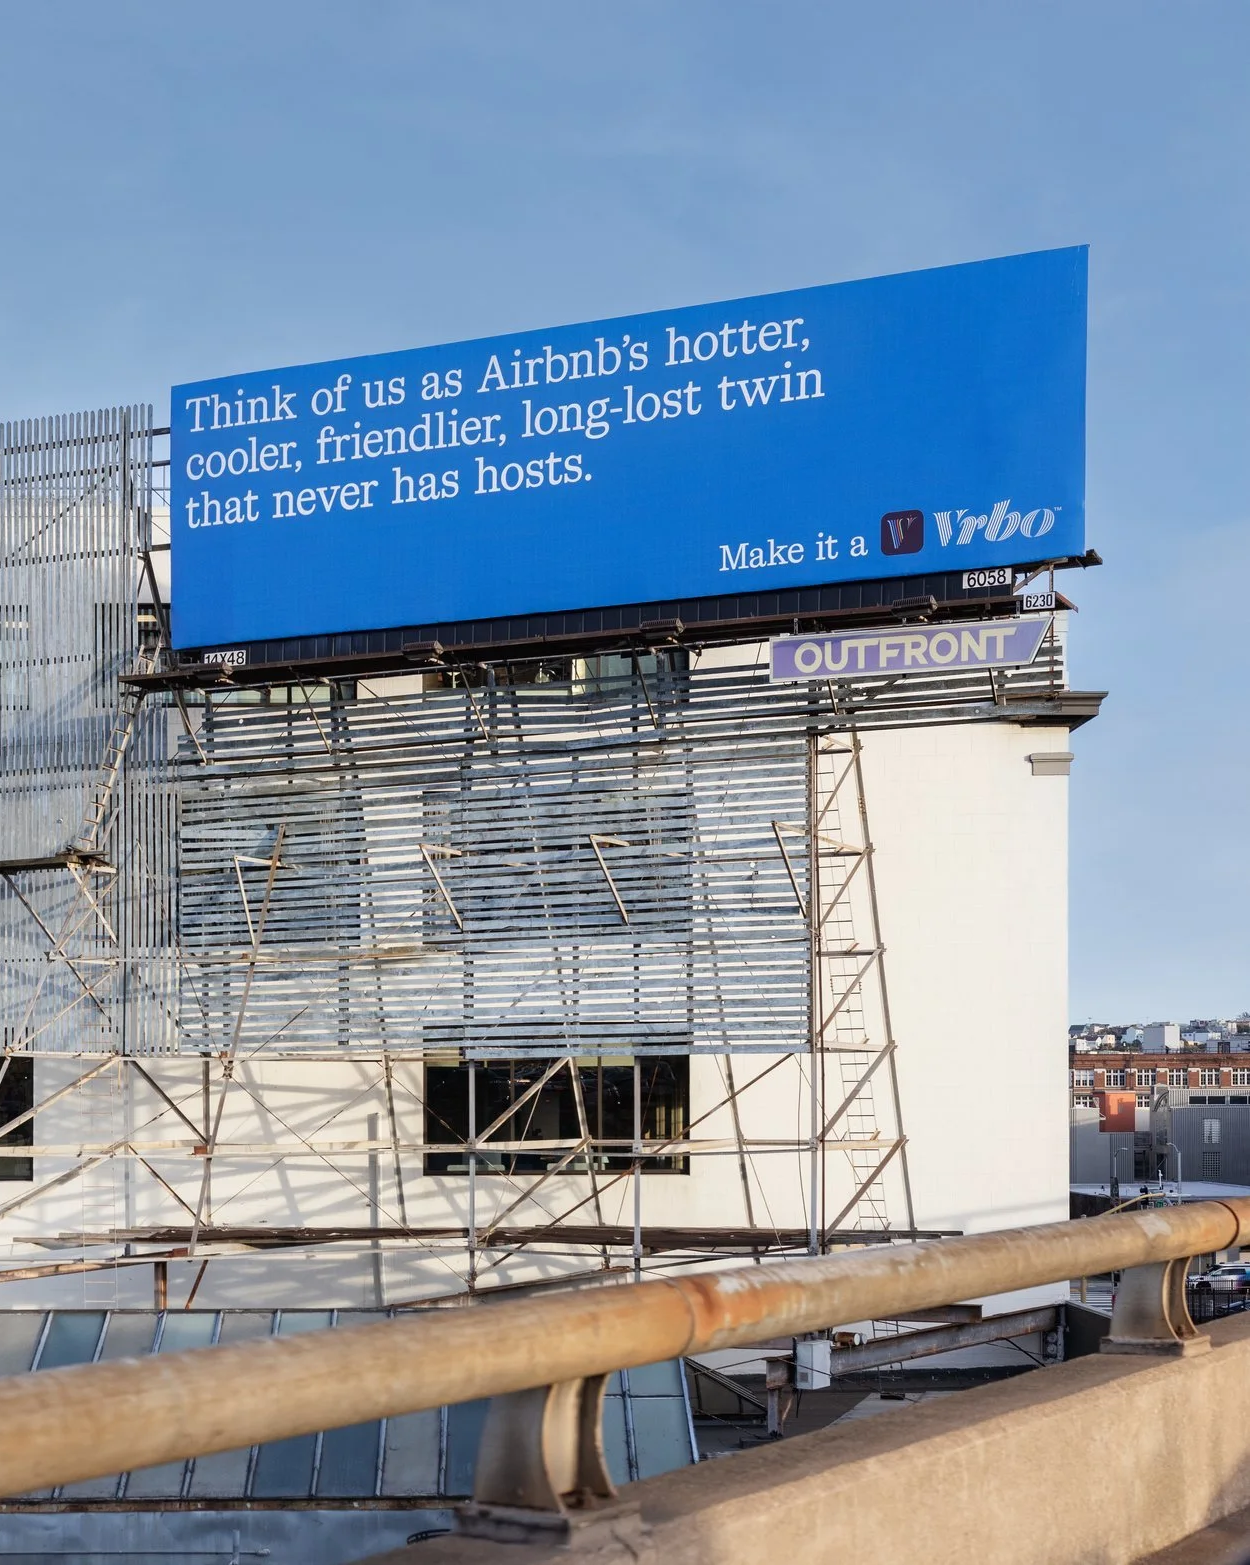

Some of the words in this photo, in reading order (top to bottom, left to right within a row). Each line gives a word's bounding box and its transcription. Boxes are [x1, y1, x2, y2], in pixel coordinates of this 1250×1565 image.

[185, 384, 298, 433] Think
[310, 373, 352, 416] of
[361, 376, 406, 409] us
[421, 368, 463, 401] as
[476, 334, 649, 394] Airbnb’s
[664, 317, 810, 367] hotter,
[185, 436, 303, 481] cooler,
[316, 408, 507, 465] friendlier,
[521, 380, 702, 440] long-lost
[717, 360, 826, 411] twin
[184, 489, 260, 529] that
[272, 479, 379, 519] never
[391, 466, 460, 505] has
[474, 451, 592, 495] hosts.
[718, 538, 805, 572] Make
[815, 531, 839, 561] it
[849, 535, 869, 558] a
[966, 567, 1007, 588] 6058
[1025, 593, 1053, 609] 6230
[793, 626, 1018, 674] OUTFRONT
